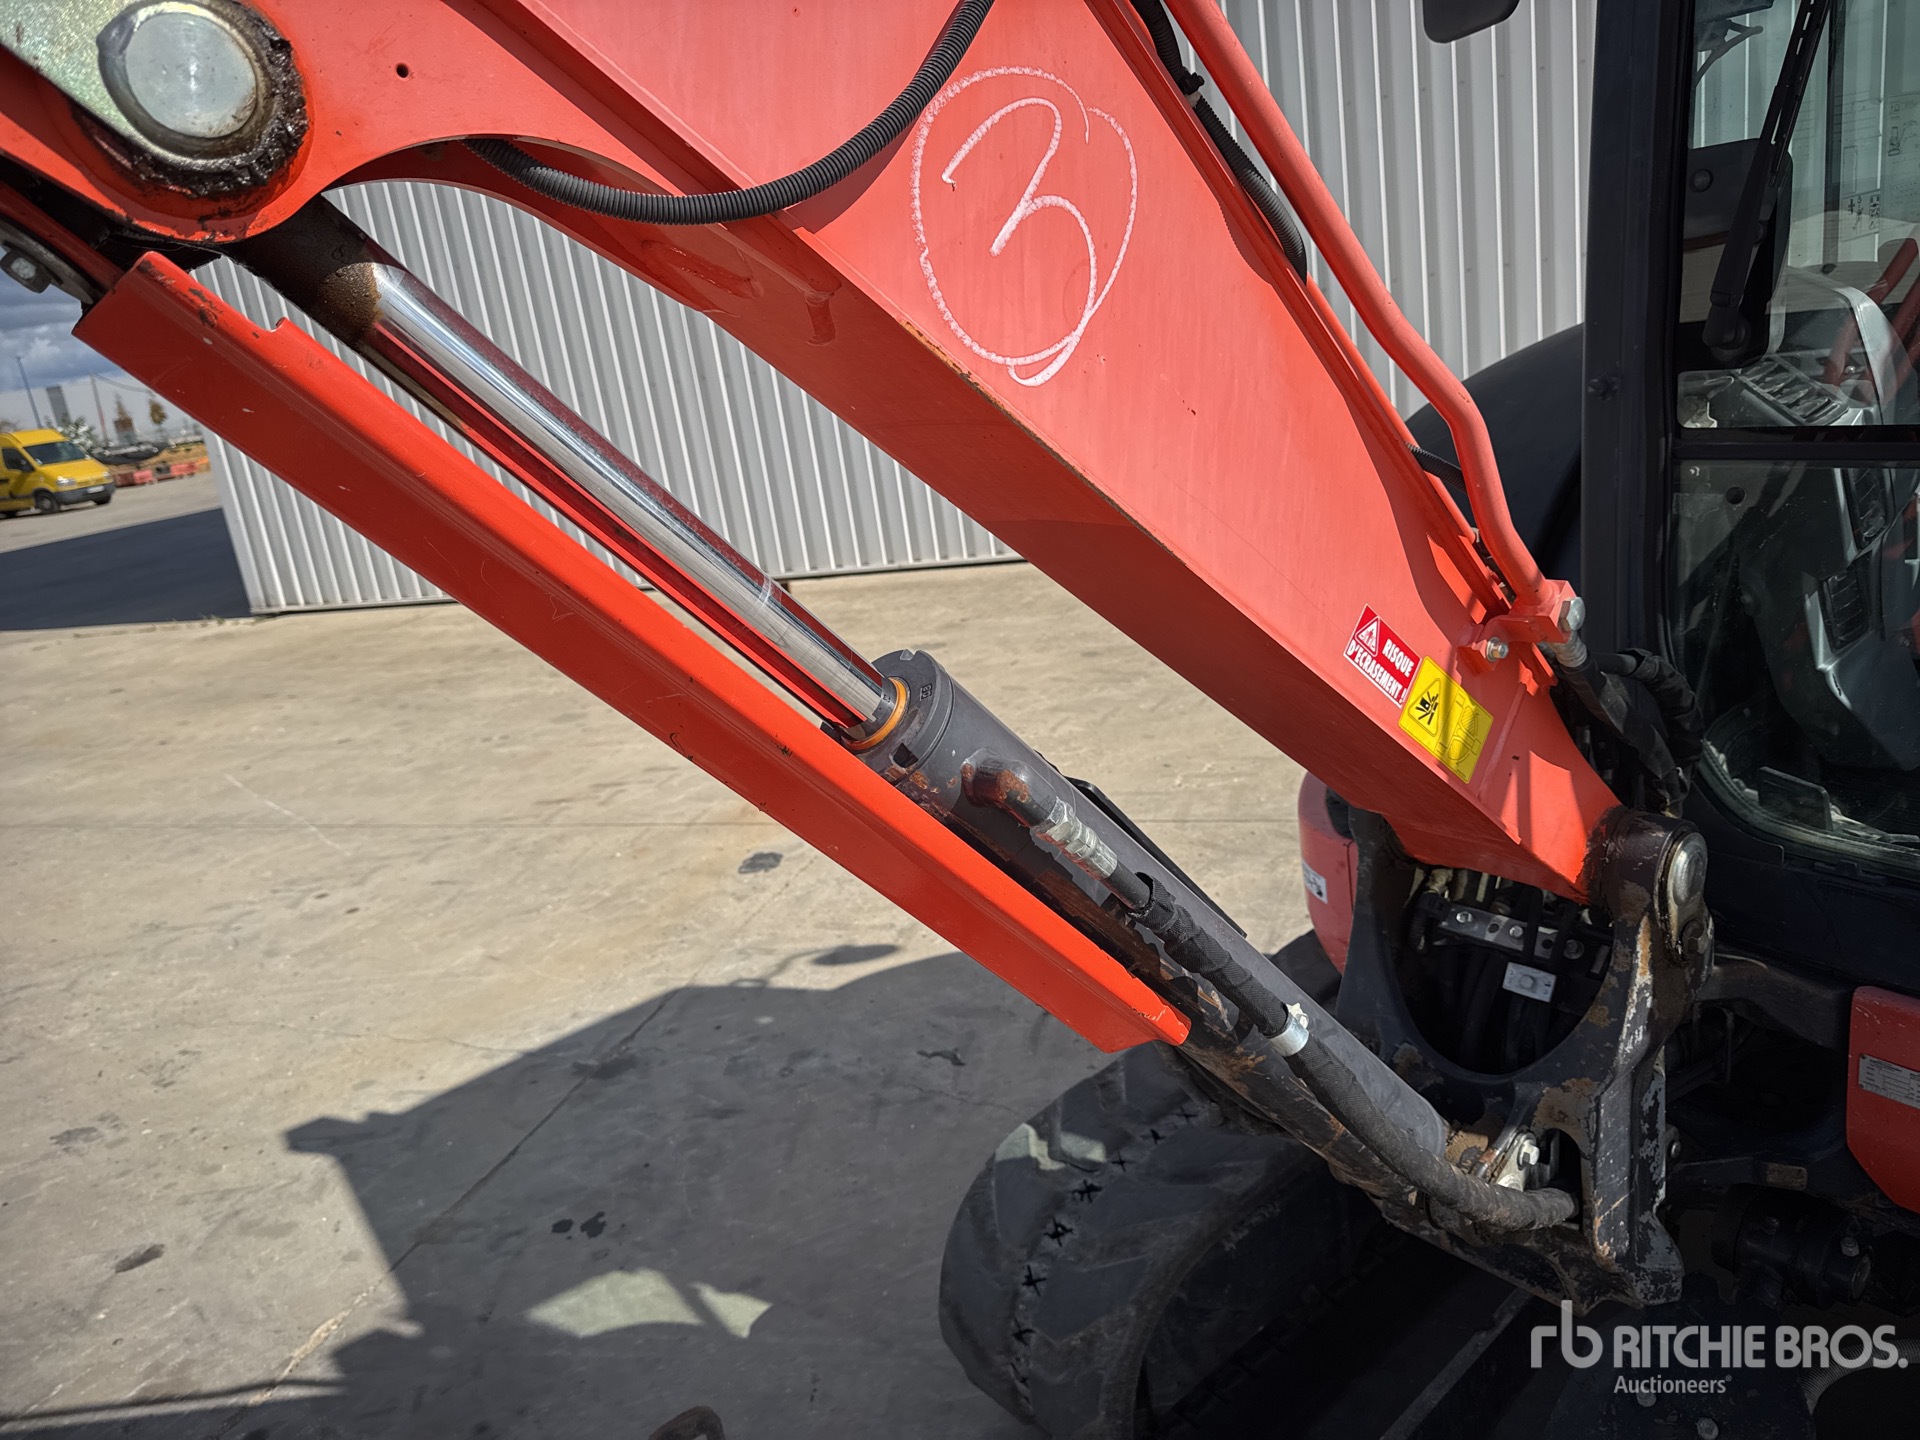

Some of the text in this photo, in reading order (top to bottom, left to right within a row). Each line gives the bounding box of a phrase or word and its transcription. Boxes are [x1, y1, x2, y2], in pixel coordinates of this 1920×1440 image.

[942, 97, 1098, 387] 3
[1346, 639, 1403, 698] D'ECRASEMENT
[1382, 639, 1415, 678] RISQUE
